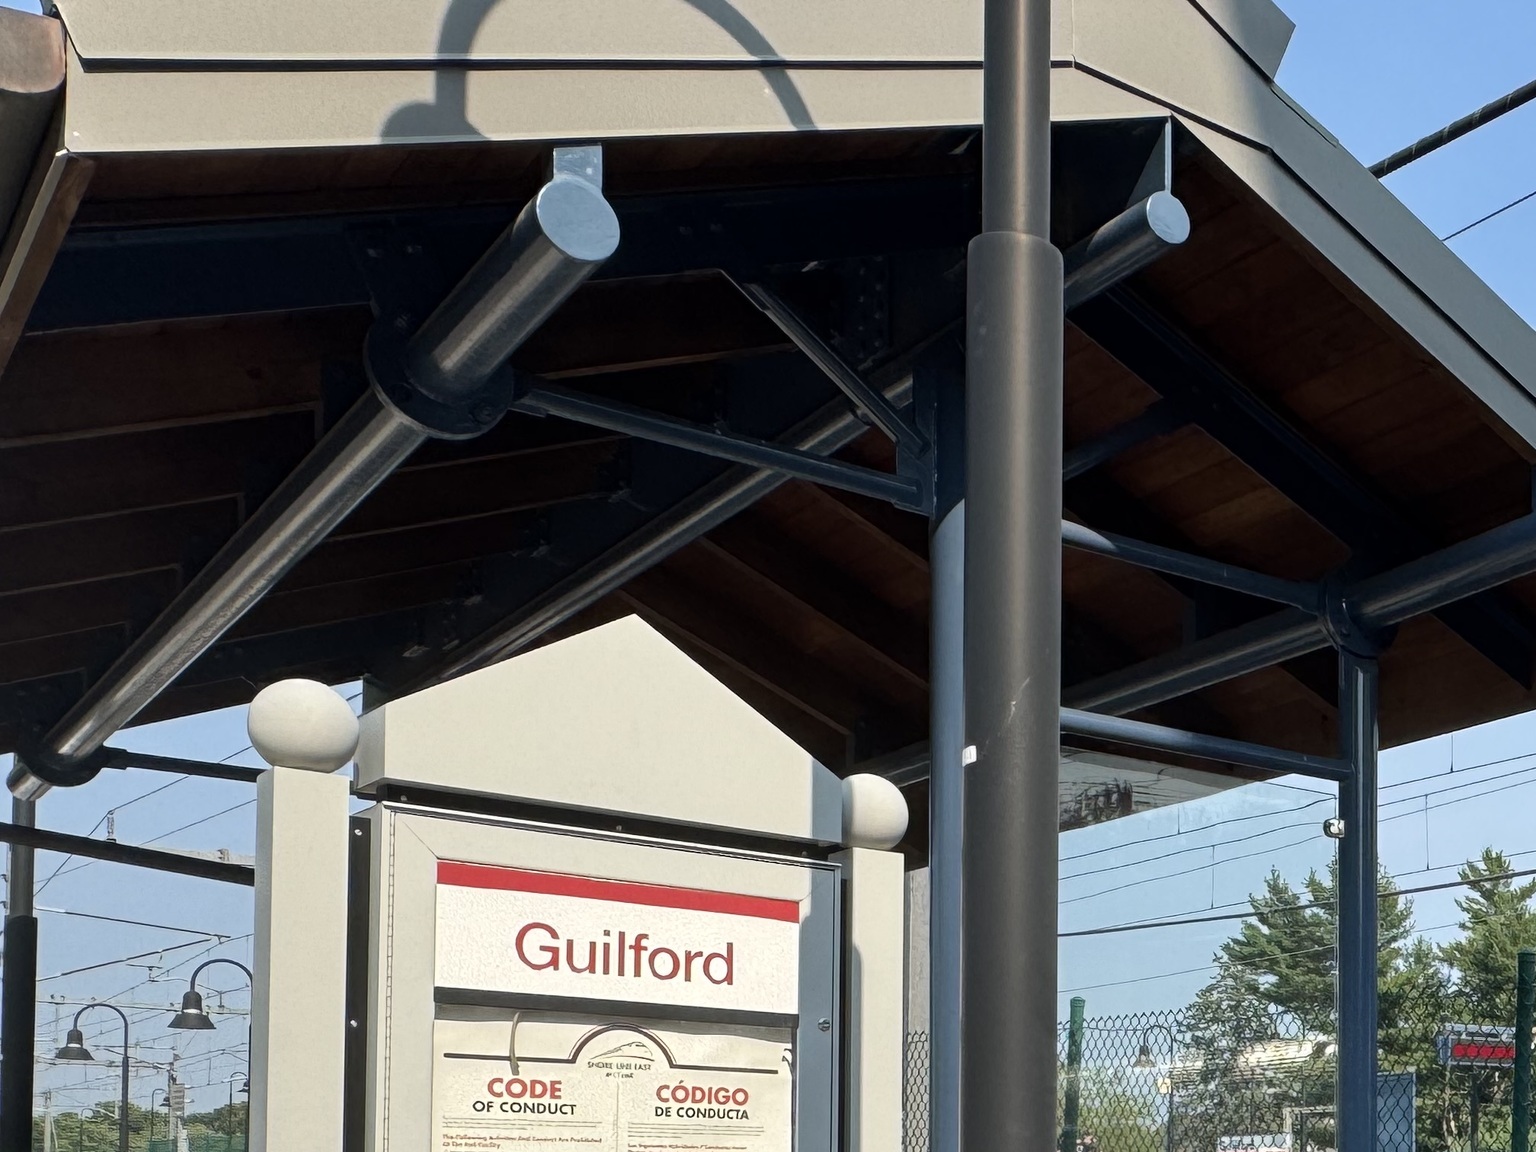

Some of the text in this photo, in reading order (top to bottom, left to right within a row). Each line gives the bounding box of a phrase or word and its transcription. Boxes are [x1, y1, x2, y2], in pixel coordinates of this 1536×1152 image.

[515, 921, 734, 986] Guilford
[487, 1077, 562, 1100] CODE
[656, 1079, 750, 1106] CÓDIGO
[472, 1100, 577, 1116] OF CONDUCT
[654, 1106, 750, 1120] DE CONDUCTA
